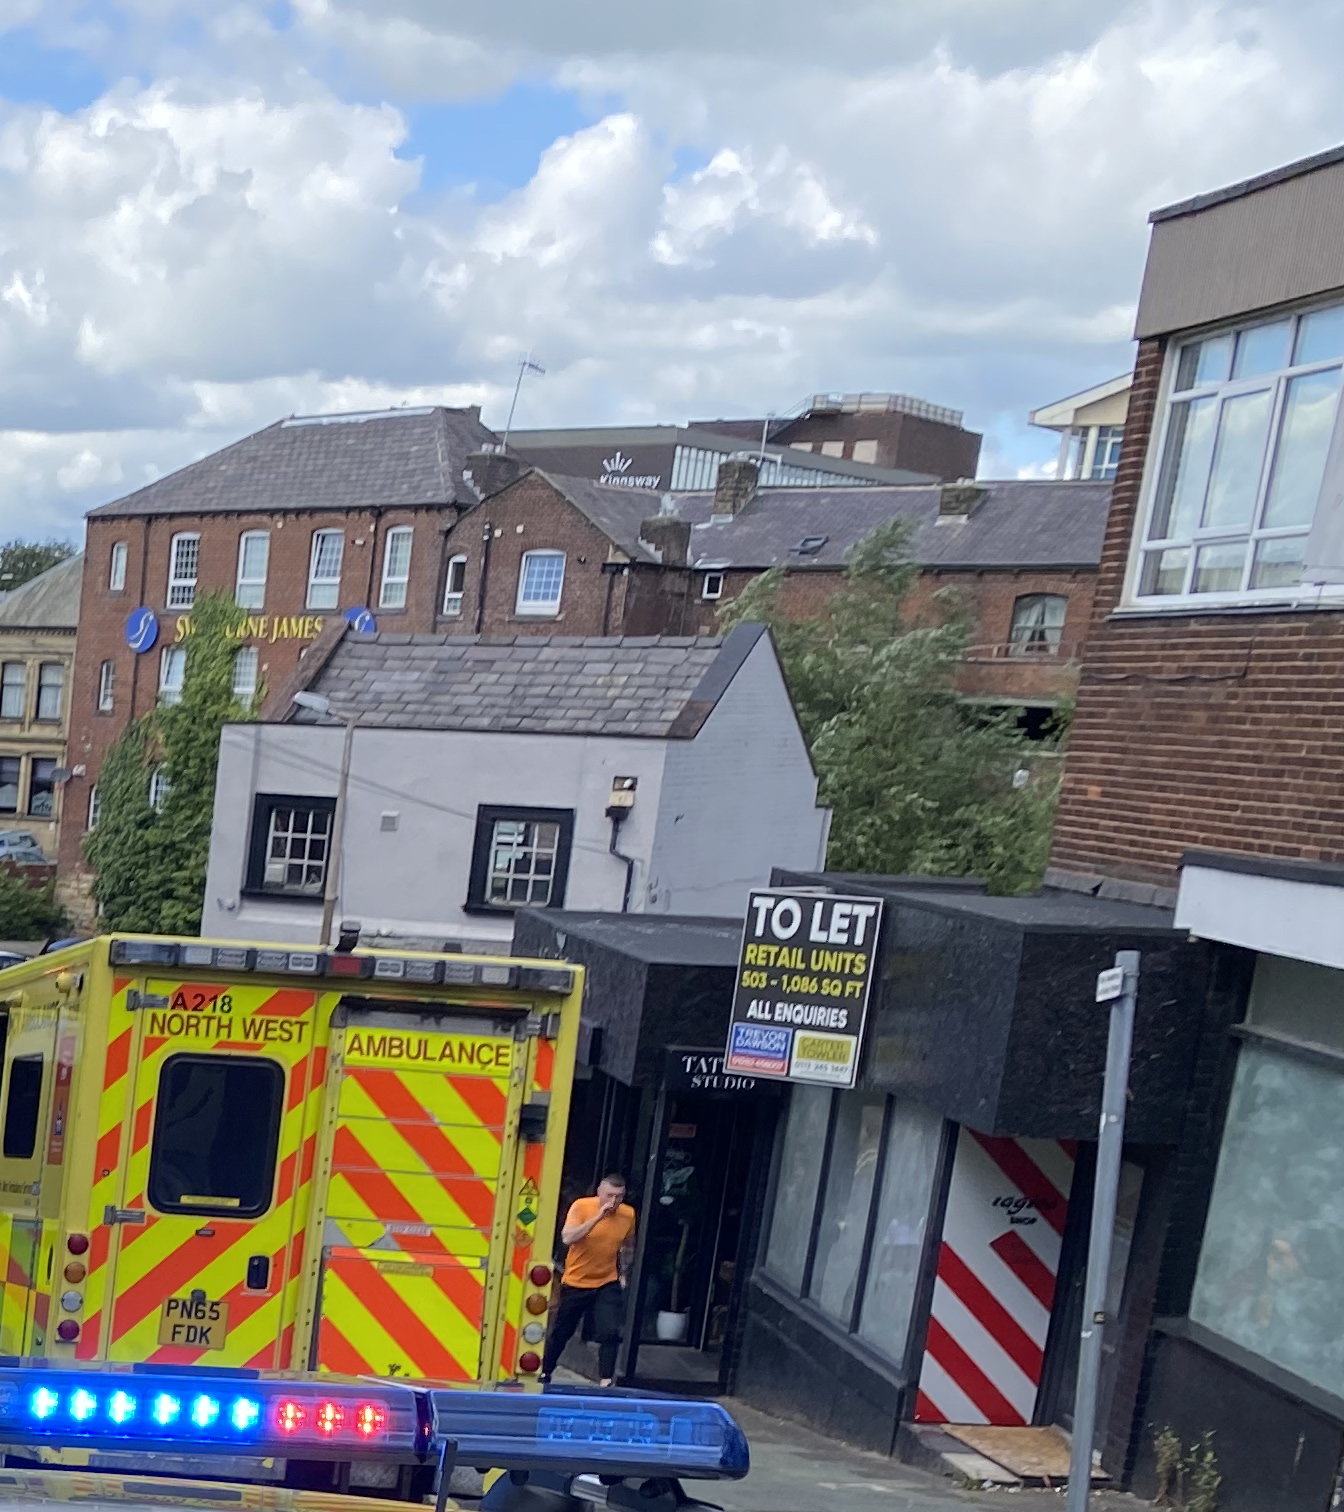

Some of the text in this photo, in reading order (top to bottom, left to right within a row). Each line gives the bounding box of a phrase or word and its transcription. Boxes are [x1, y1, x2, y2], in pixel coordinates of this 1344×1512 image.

[269, 615, 324, 644] JAMES
[752, 896, 876, 946] TO LET
[744, 943, 867, 975] RETAIL UNITS
[741, 970, 768, 989] 503
[781, 974, 819, 994] 1,086
[820, 978, 842, 997] SQ
[844, 981, 864, 998] FT
[170, 992, 233, 1013] A218
[746, 999, 849, 1029] ALL ENQUIRIES
[149, 1012, 309, 1043] NORTH WEST
[346, 1033, 511, 1067] AMBULANCE
[734, 1038, 786, 1052] DAWSON
[691, 1074, 755, 1090] STUDIO
[166, 1298, 220, 1321] PN65
[171, 1323, 212, 1345] FDK
